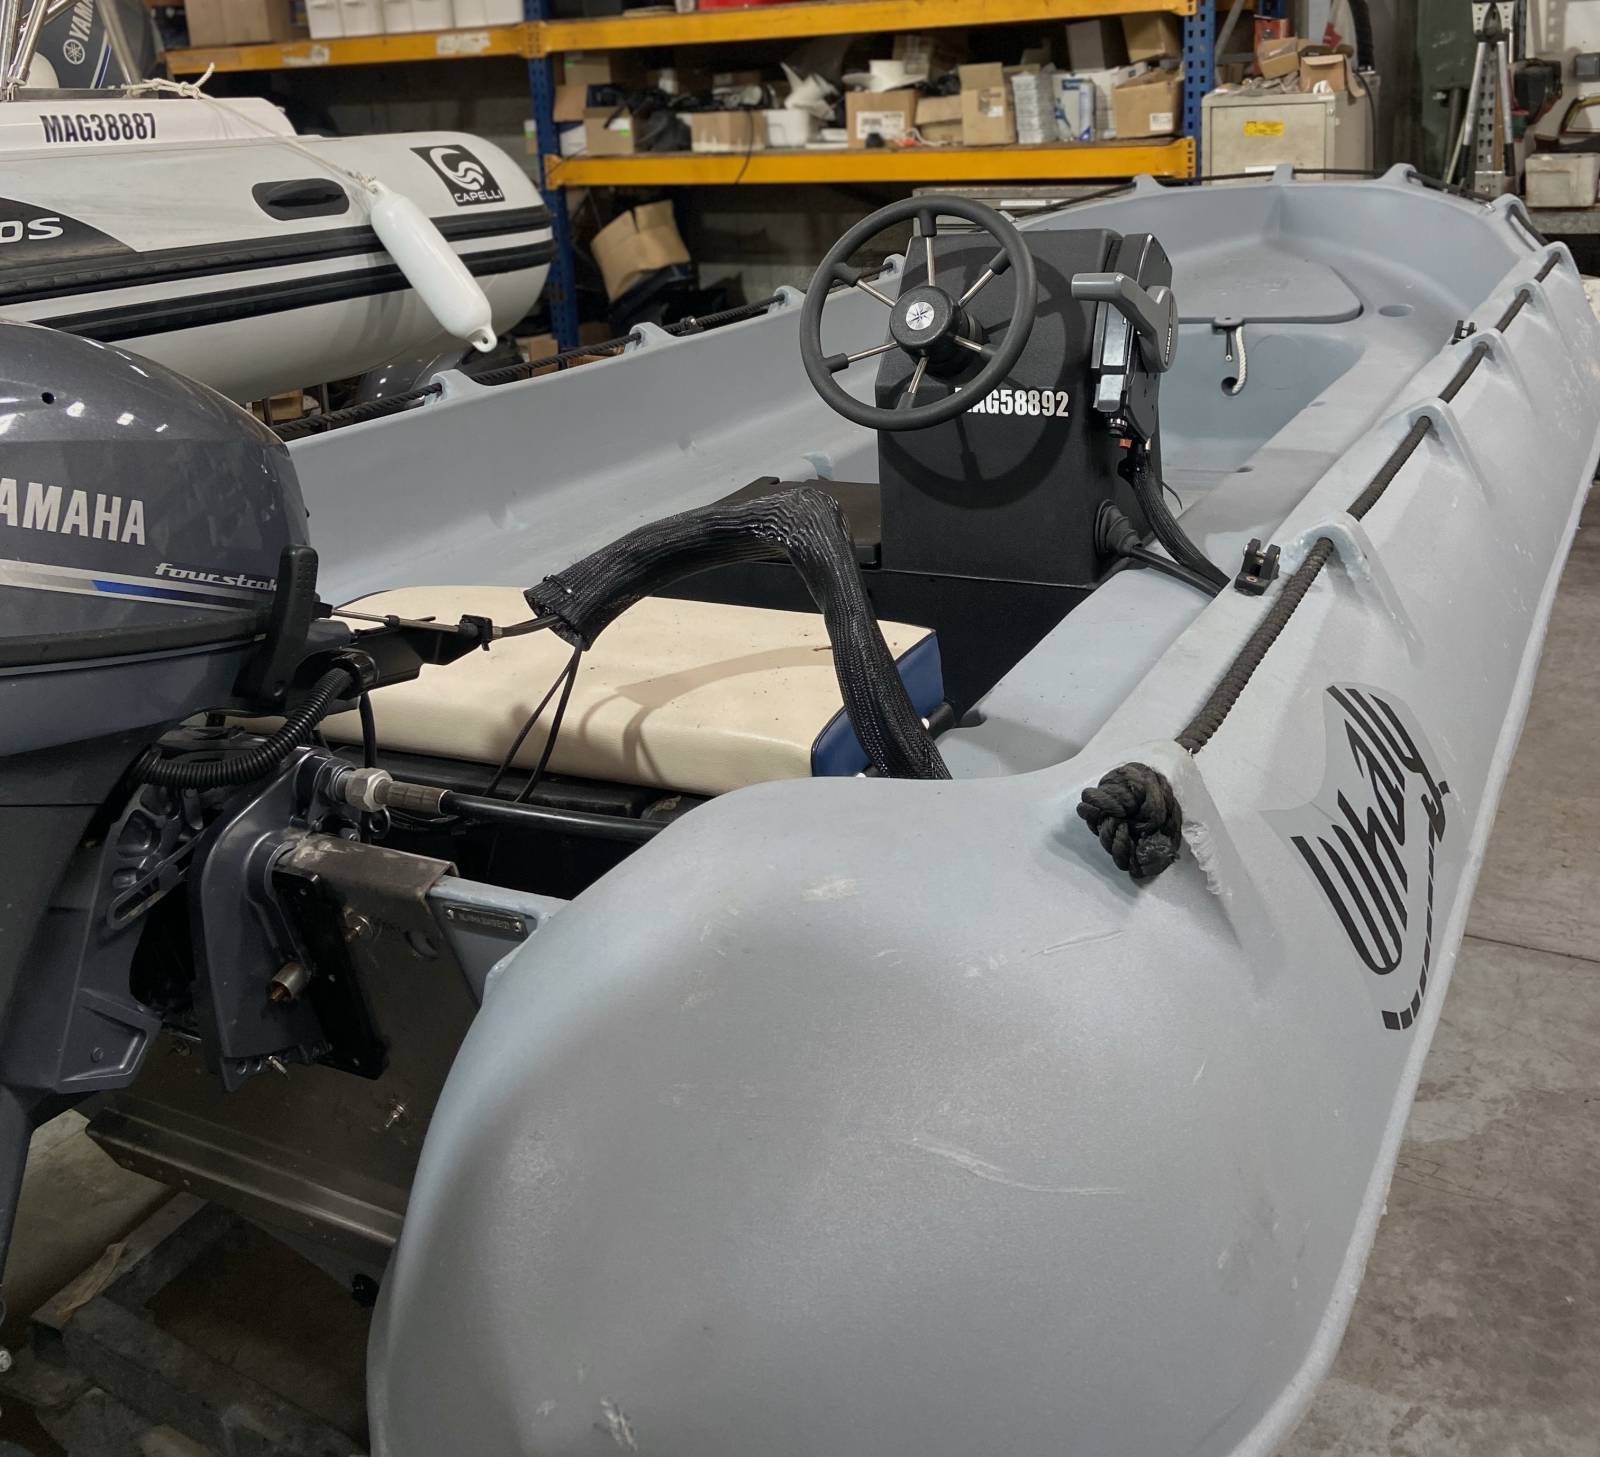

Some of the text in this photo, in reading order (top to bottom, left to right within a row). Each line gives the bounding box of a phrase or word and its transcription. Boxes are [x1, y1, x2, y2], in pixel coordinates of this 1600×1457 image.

[40, 113, 156, 143] MAG38887
[454, 190, 503, 203] CAPELLI
[954, 387, 1069, 417] G58892
[0, 477, 146, 546] AMAHA
